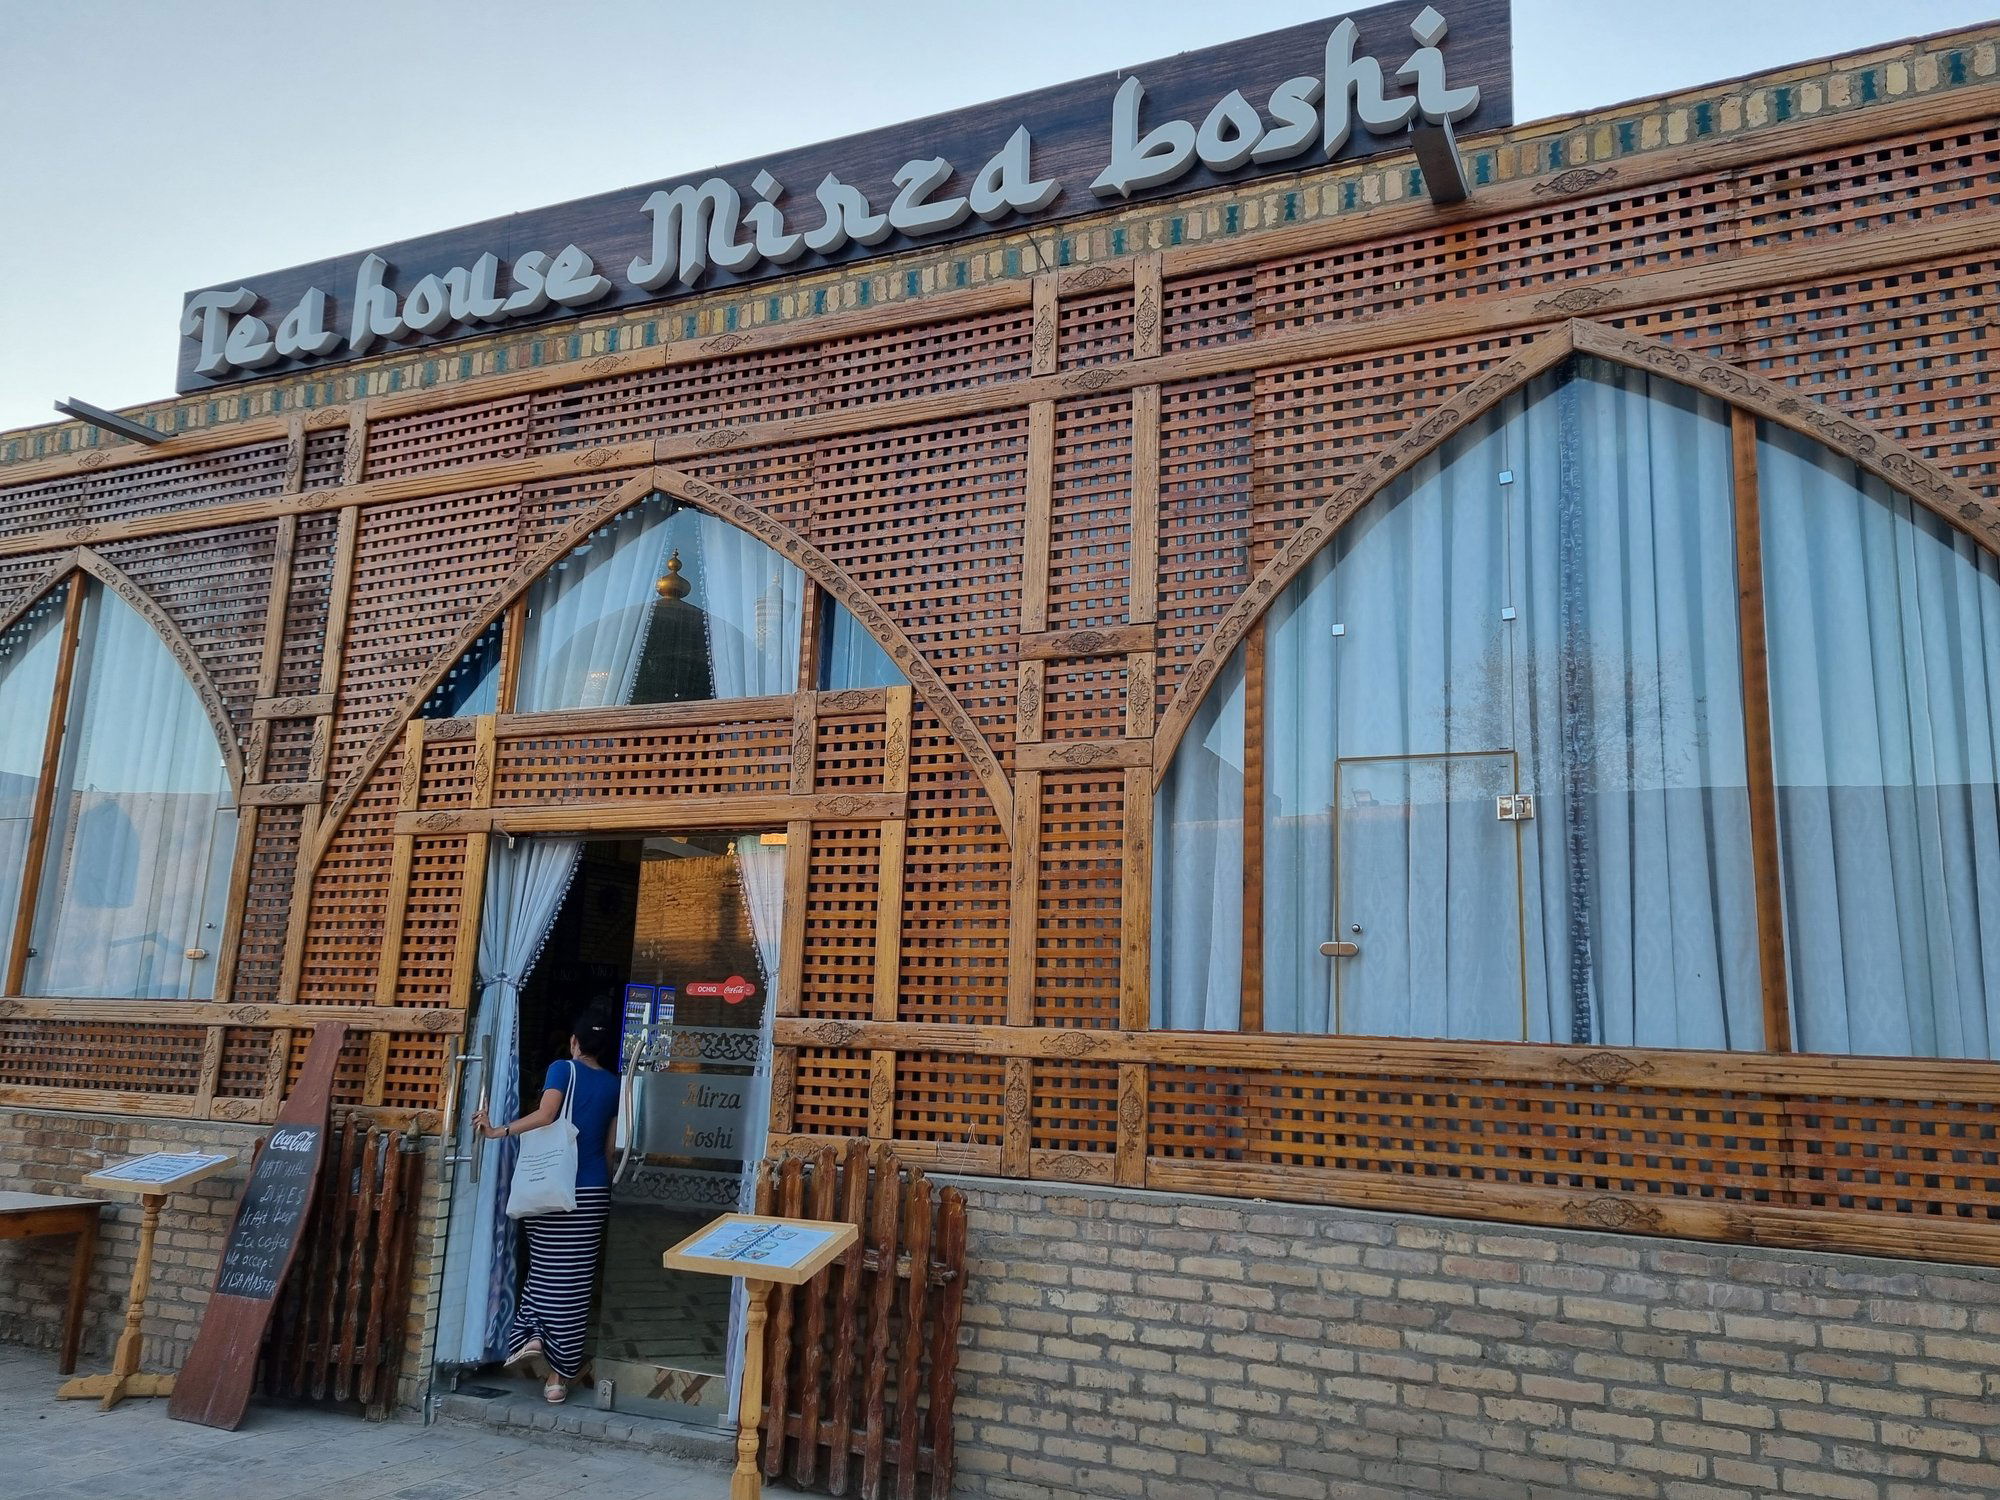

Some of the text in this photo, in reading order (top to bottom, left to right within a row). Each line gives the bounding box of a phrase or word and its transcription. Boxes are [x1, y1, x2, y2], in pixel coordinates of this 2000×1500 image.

[350, 244, 612, 357] house
[627, 124, 1061, 291] Mirza
[1089, 5, 1480, 199] boshi
[681, 1082, 742, 1109] Mirza
